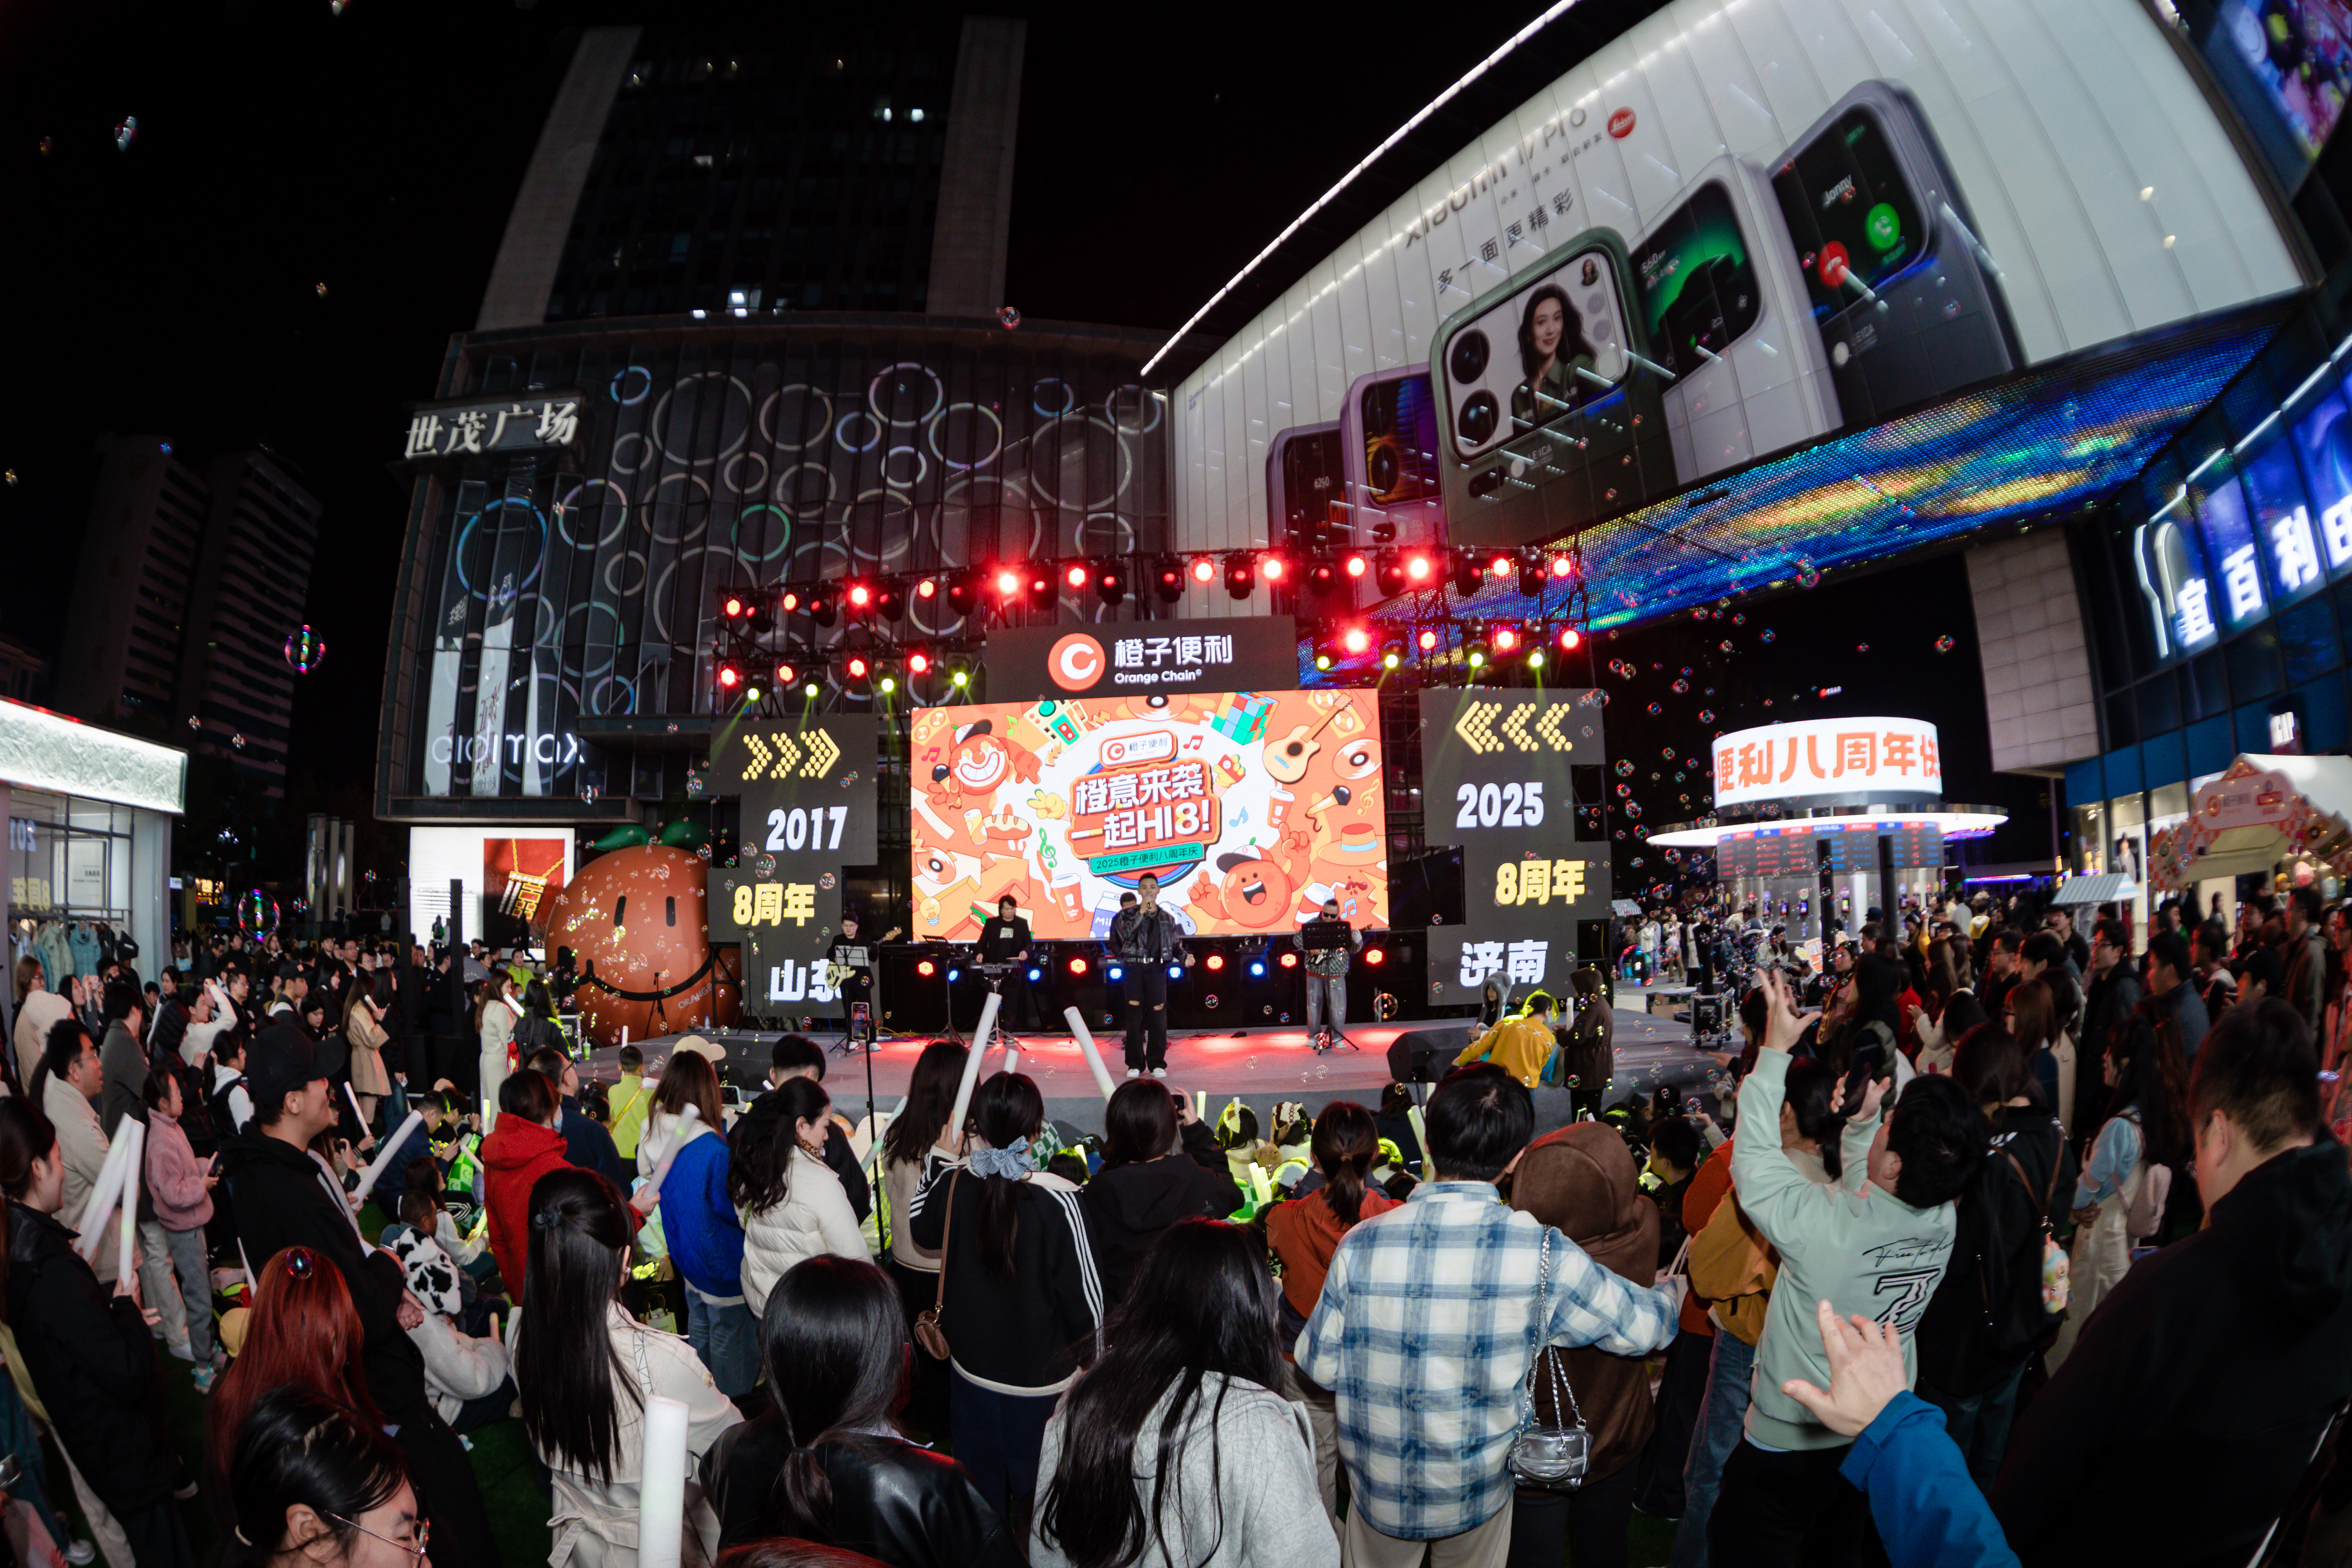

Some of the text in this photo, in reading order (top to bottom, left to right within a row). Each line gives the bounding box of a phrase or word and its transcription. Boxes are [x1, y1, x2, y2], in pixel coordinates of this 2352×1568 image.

[1437, 187, 1573, 294] 多一面更精彩
[404, 401, 579, 459] 世茂广场
[1114, 634, 1233, 668] 橙子便利
[1114, 672, 1159, 685] Orange
[1129, 737, 1167, 751] 橙子便利
[1075, 763, 1204, 815] 橙意来袭
[1456, 782, 1544, 828] 2025
[766, 806, 848, 851] 2017
[1096, 846, 1198, 869] 2025橙子便利八周年庆
[732, 883, 815, 926] 8周年
[1495, 859, 1585, 906] 8周年
[1095, 916, 1112, 926] Mil
[1460, 939, 1548, 987] 济南
[678, 983, 712, 1009] ORANGE
